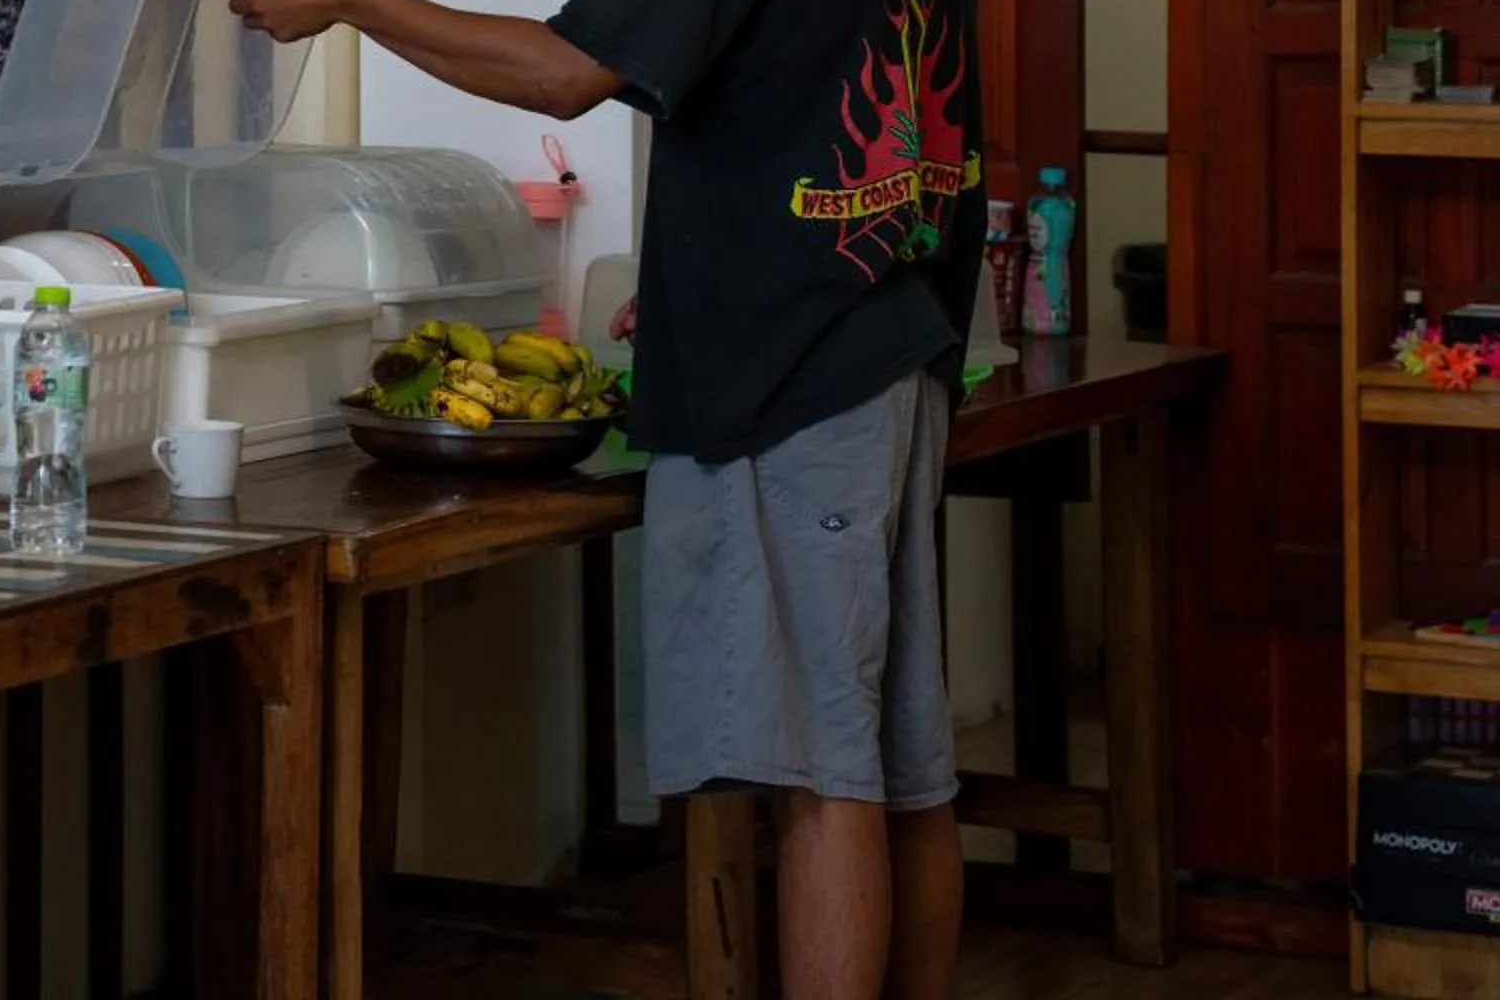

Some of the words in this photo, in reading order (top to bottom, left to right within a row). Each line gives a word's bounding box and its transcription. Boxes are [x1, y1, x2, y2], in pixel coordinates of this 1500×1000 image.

[801, 192, 854, 216] WEST
[861, 176, 913, 209] COAST
[1373, 830, 1457, 855] MONOPOLY
